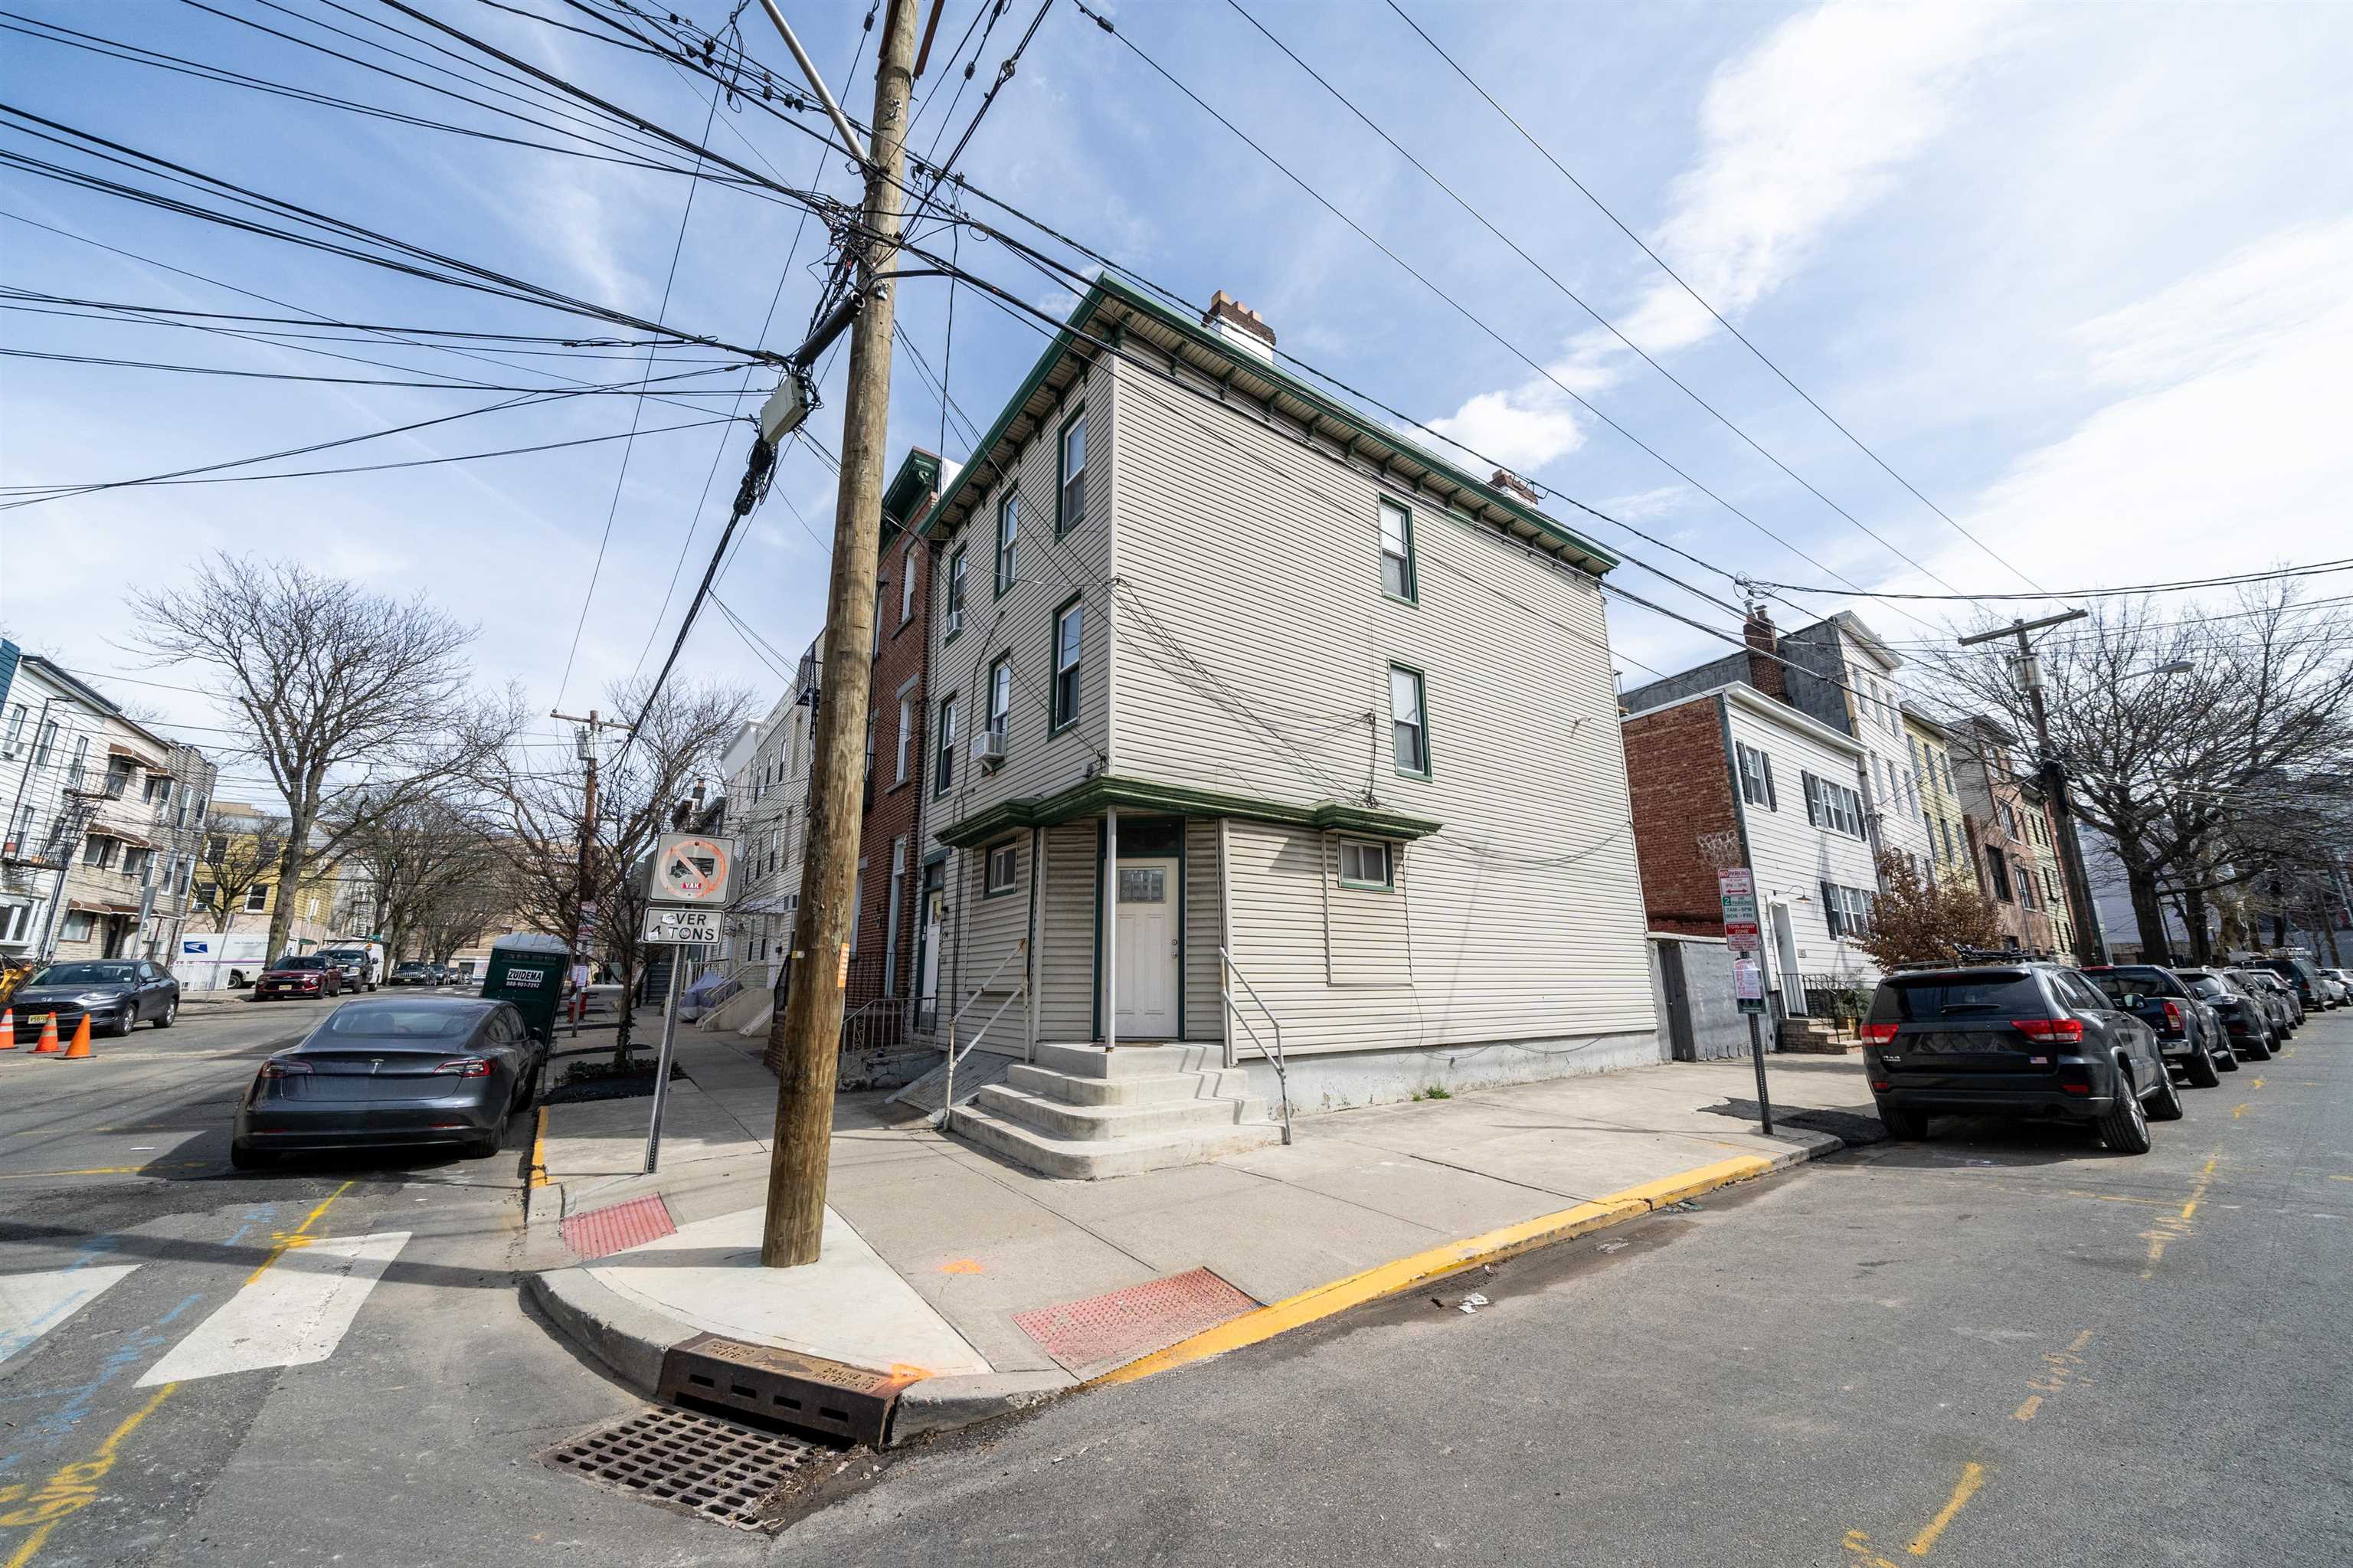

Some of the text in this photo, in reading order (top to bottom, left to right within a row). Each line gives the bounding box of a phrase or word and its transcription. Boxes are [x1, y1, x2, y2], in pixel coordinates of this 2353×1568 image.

[1723, 897, 1730, 905] 2
[662, 912, 706, 925] VER
[668, 927, 714, 941] TONS
[508, 970, 542, 980] ZUIDEMA
[822, 1367, 862, 1379] DRAINS
[813, 1373, 875, 1390] WATERWAYS
